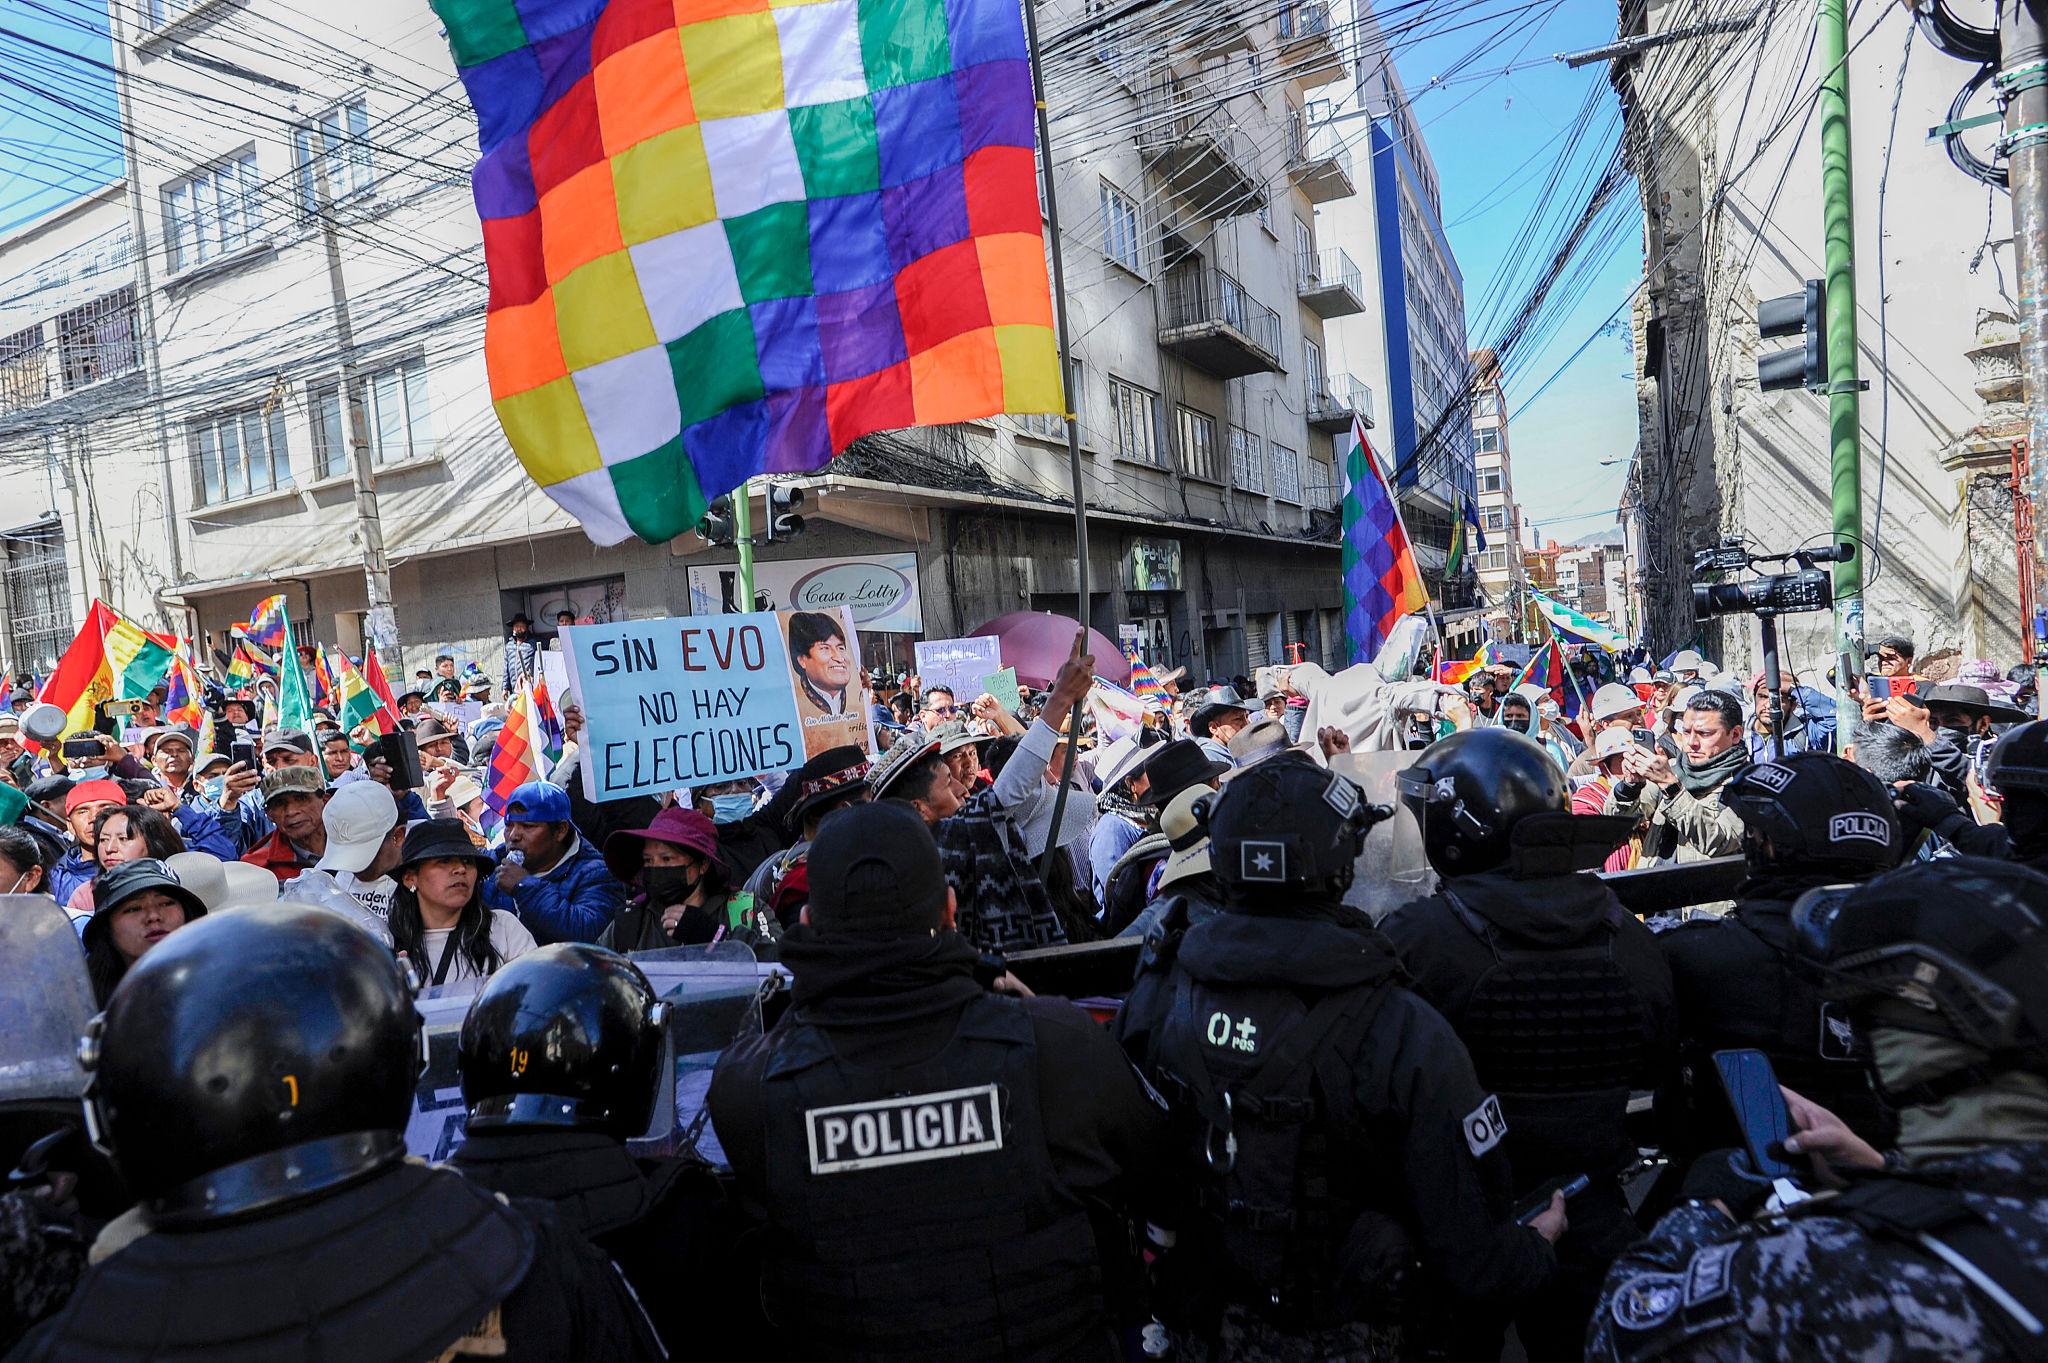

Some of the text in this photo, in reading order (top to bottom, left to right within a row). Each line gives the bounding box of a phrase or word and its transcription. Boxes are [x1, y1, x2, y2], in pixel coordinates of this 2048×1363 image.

[803, 579, 900, 605] Casa Lotty
[681, 625, 765, 671] EVO
[639, 687, 750, 726] NO HAY
[1834, 817, 1887, 841] POLICIA
[510, 1046, 528, 1073] 19
[823, 1100, 985, 1161] POLICIA
